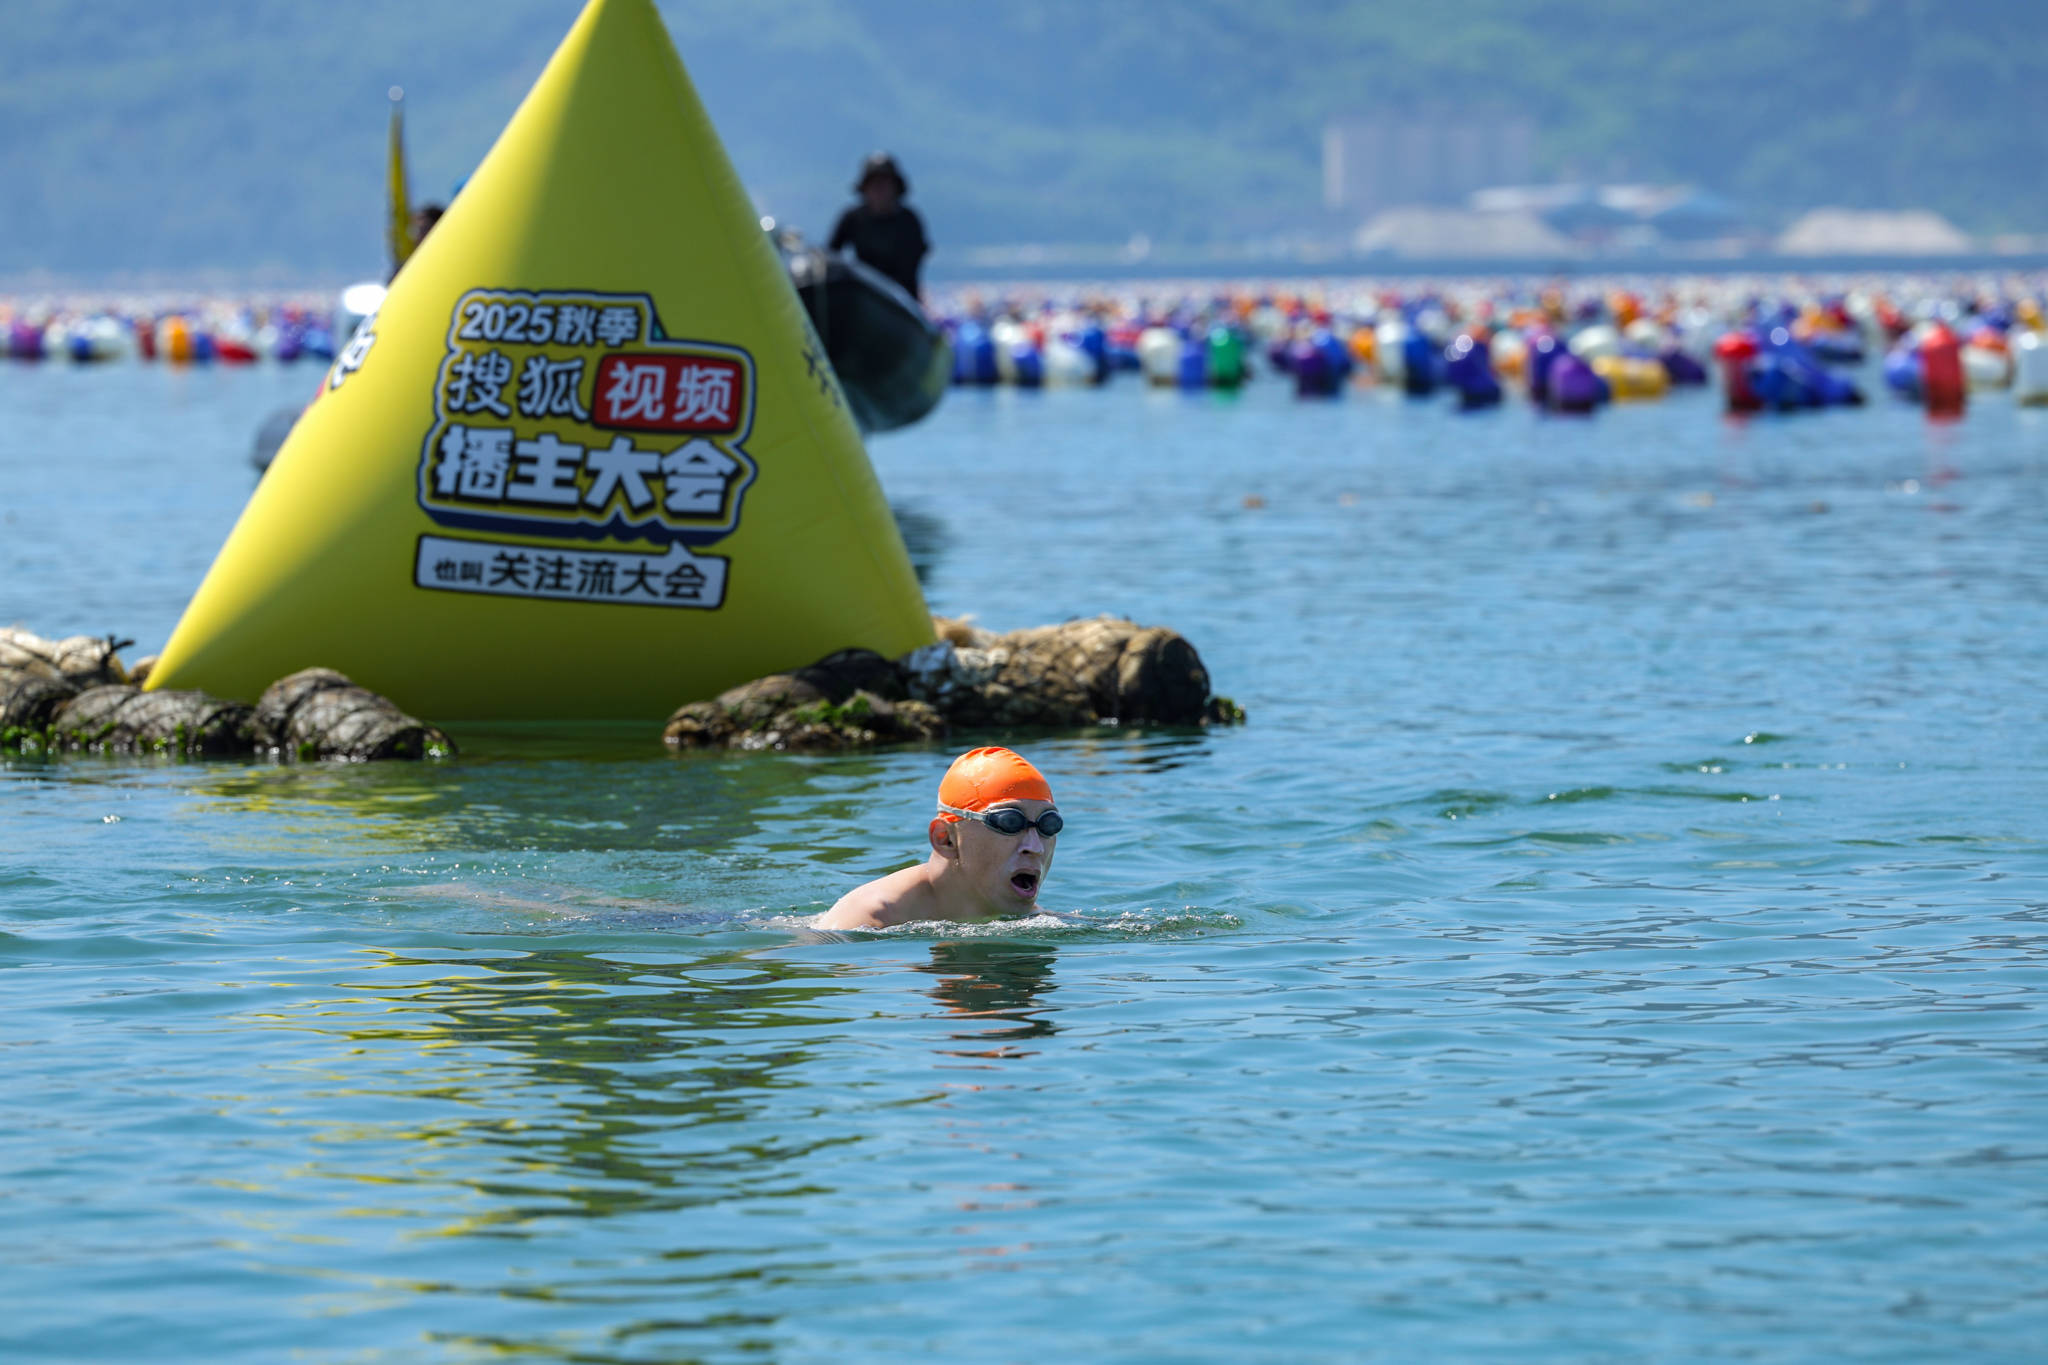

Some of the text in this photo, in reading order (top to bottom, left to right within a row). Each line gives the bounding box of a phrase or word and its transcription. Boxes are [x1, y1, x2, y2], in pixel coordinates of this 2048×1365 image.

[459, 302, 640, 346] 2025秋季
[435, 424, 740, 514] 播主大会
[434, 551, 706, 600] 也叫关注流大会
